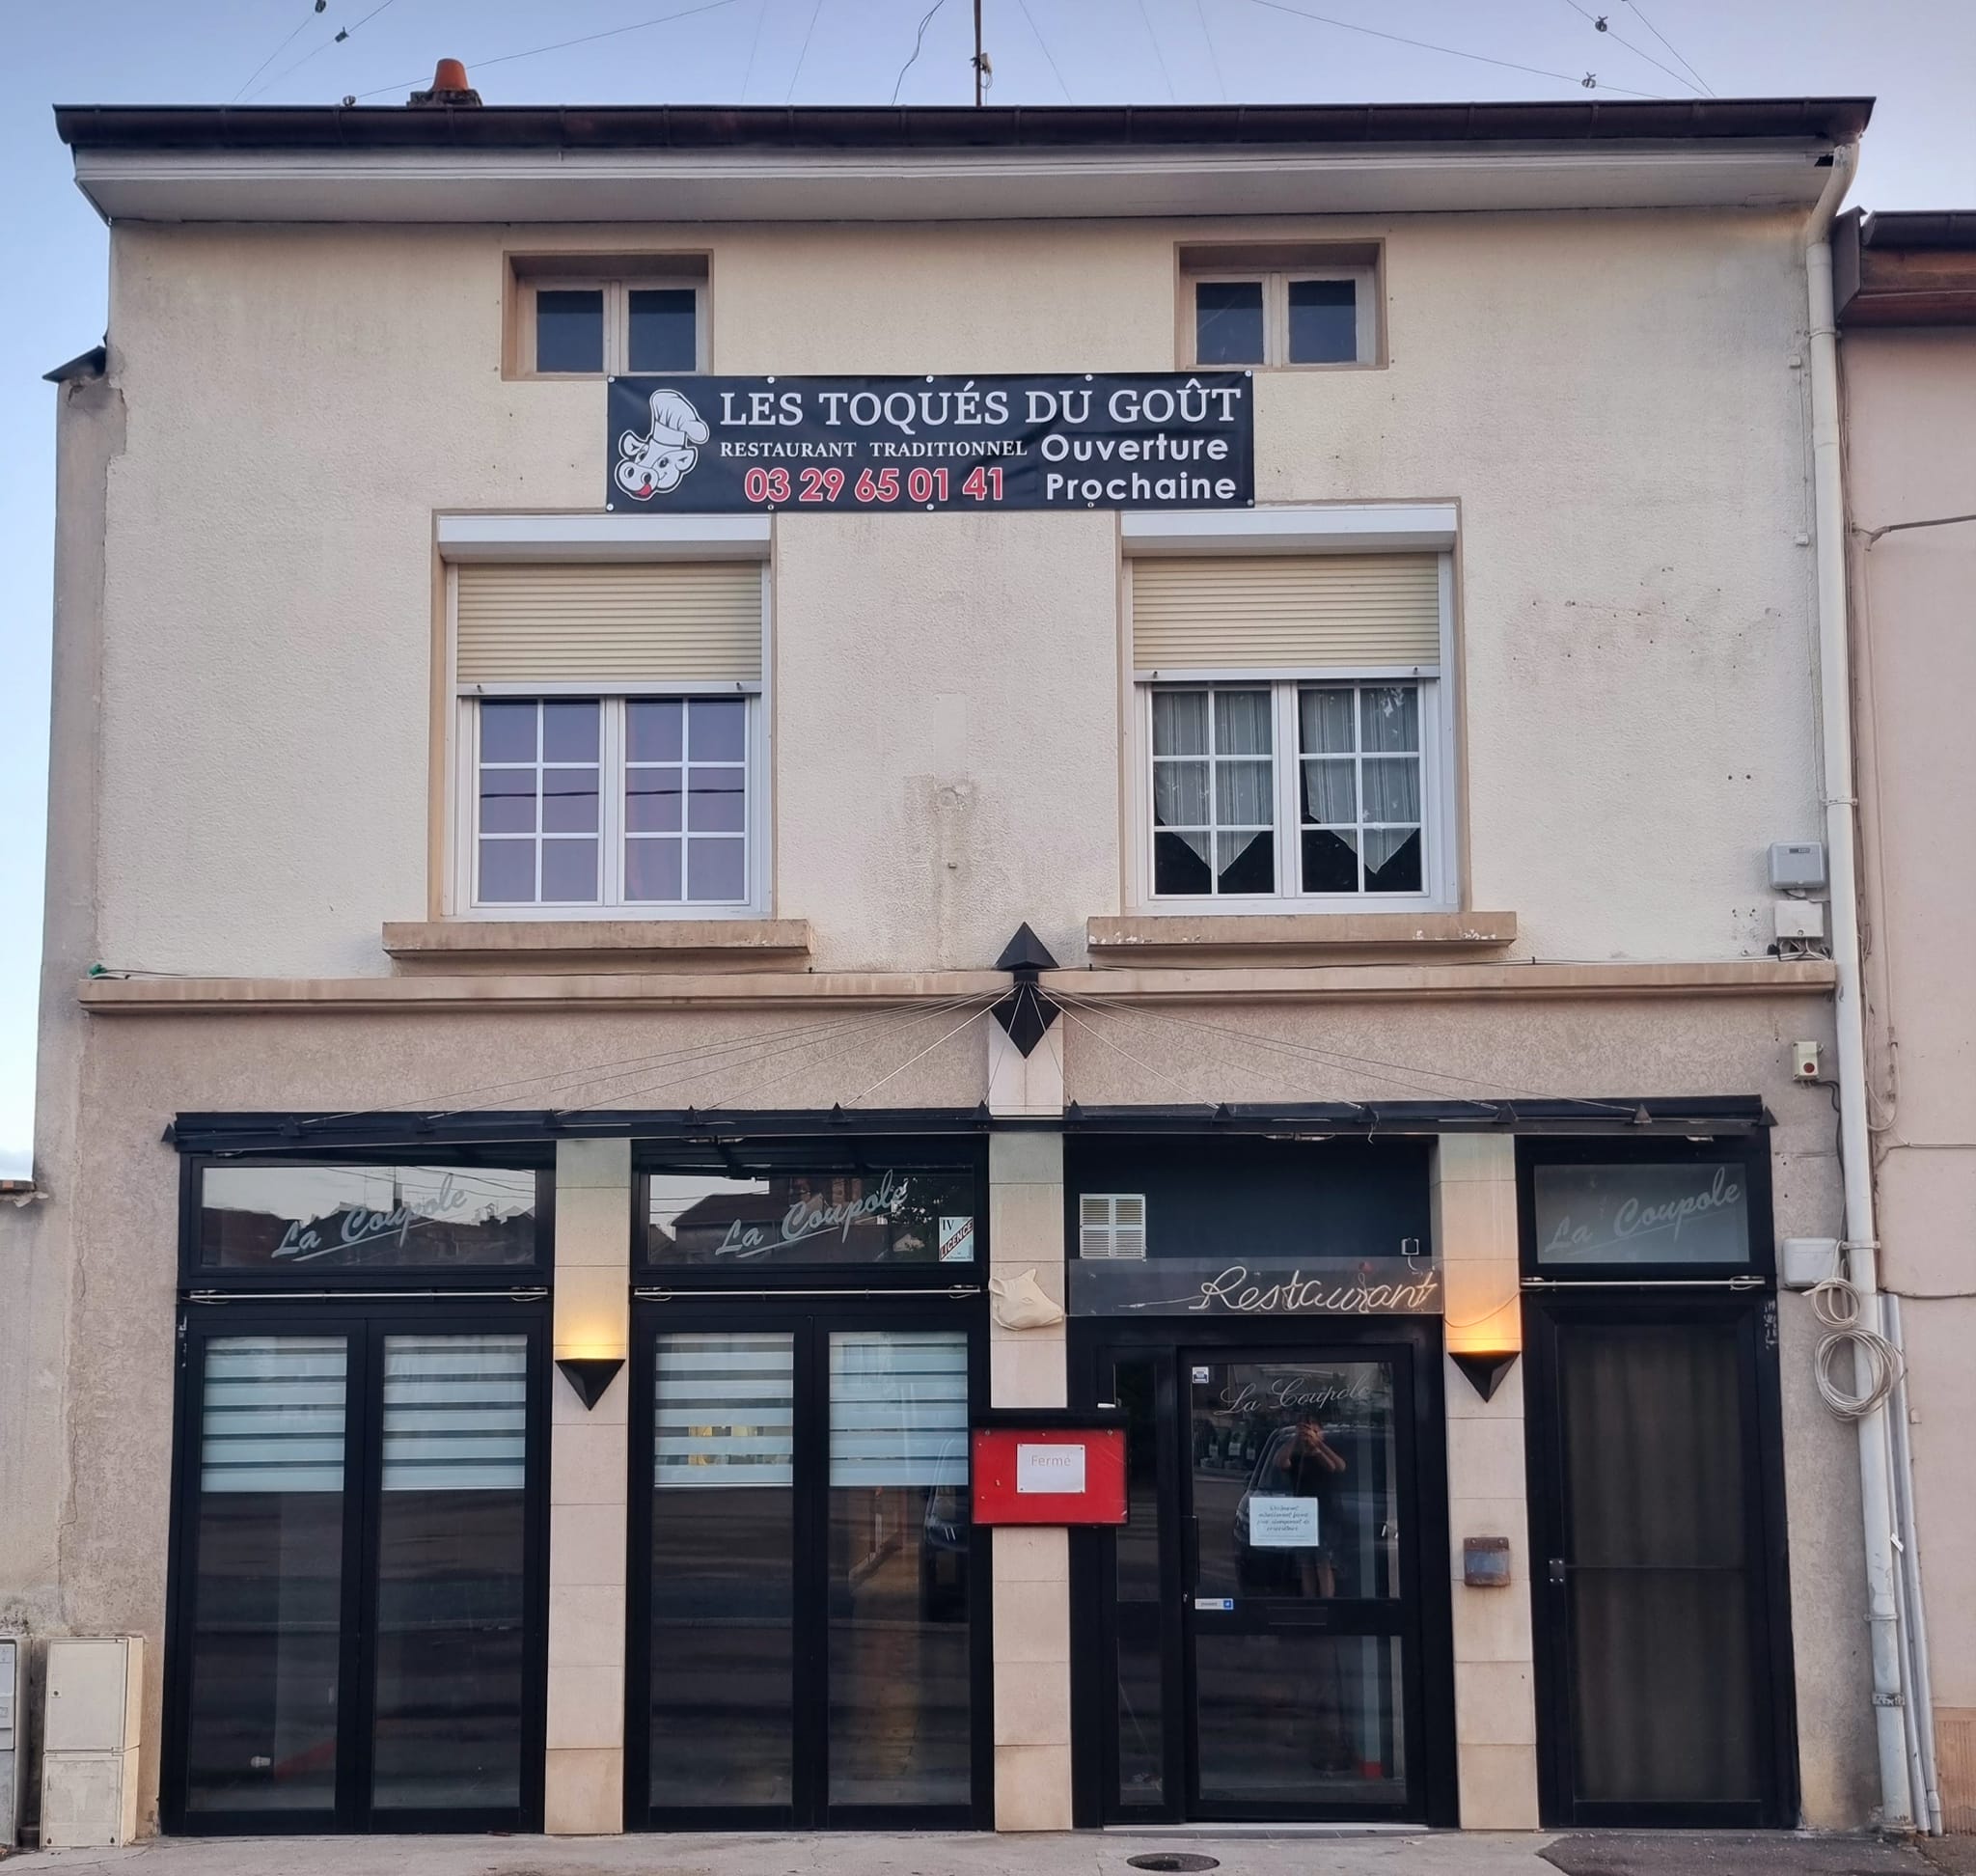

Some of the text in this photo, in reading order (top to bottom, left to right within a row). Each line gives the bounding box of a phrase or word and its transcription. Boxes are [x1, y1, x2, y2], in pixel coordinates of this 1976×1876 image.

[720, 377, 1242, 435] LES TOQUÉS DU GOÛT
[720, 440, 1028, 457] RESTAURANT TRADITIONNEL
[1041, 433, 1228, 462] Ouverture
[744, 466, 1003, 503] 03 29 65 01 41
[1046, 471, 1237, 501] Prochaine
[271, 1172, 468, 1258] La Coupole
[715, 1169, 910, 1255] La Coupole
[942, 1219, 954, 1230] IV
[1544, 1166, 1741, 1253] La Coupole
[941, 1220, 973, 1258] LICENCE
[1189, 1266, 1439, 1313] Restaurant
[1214, 1374, 1372, 1416] La Coupole
